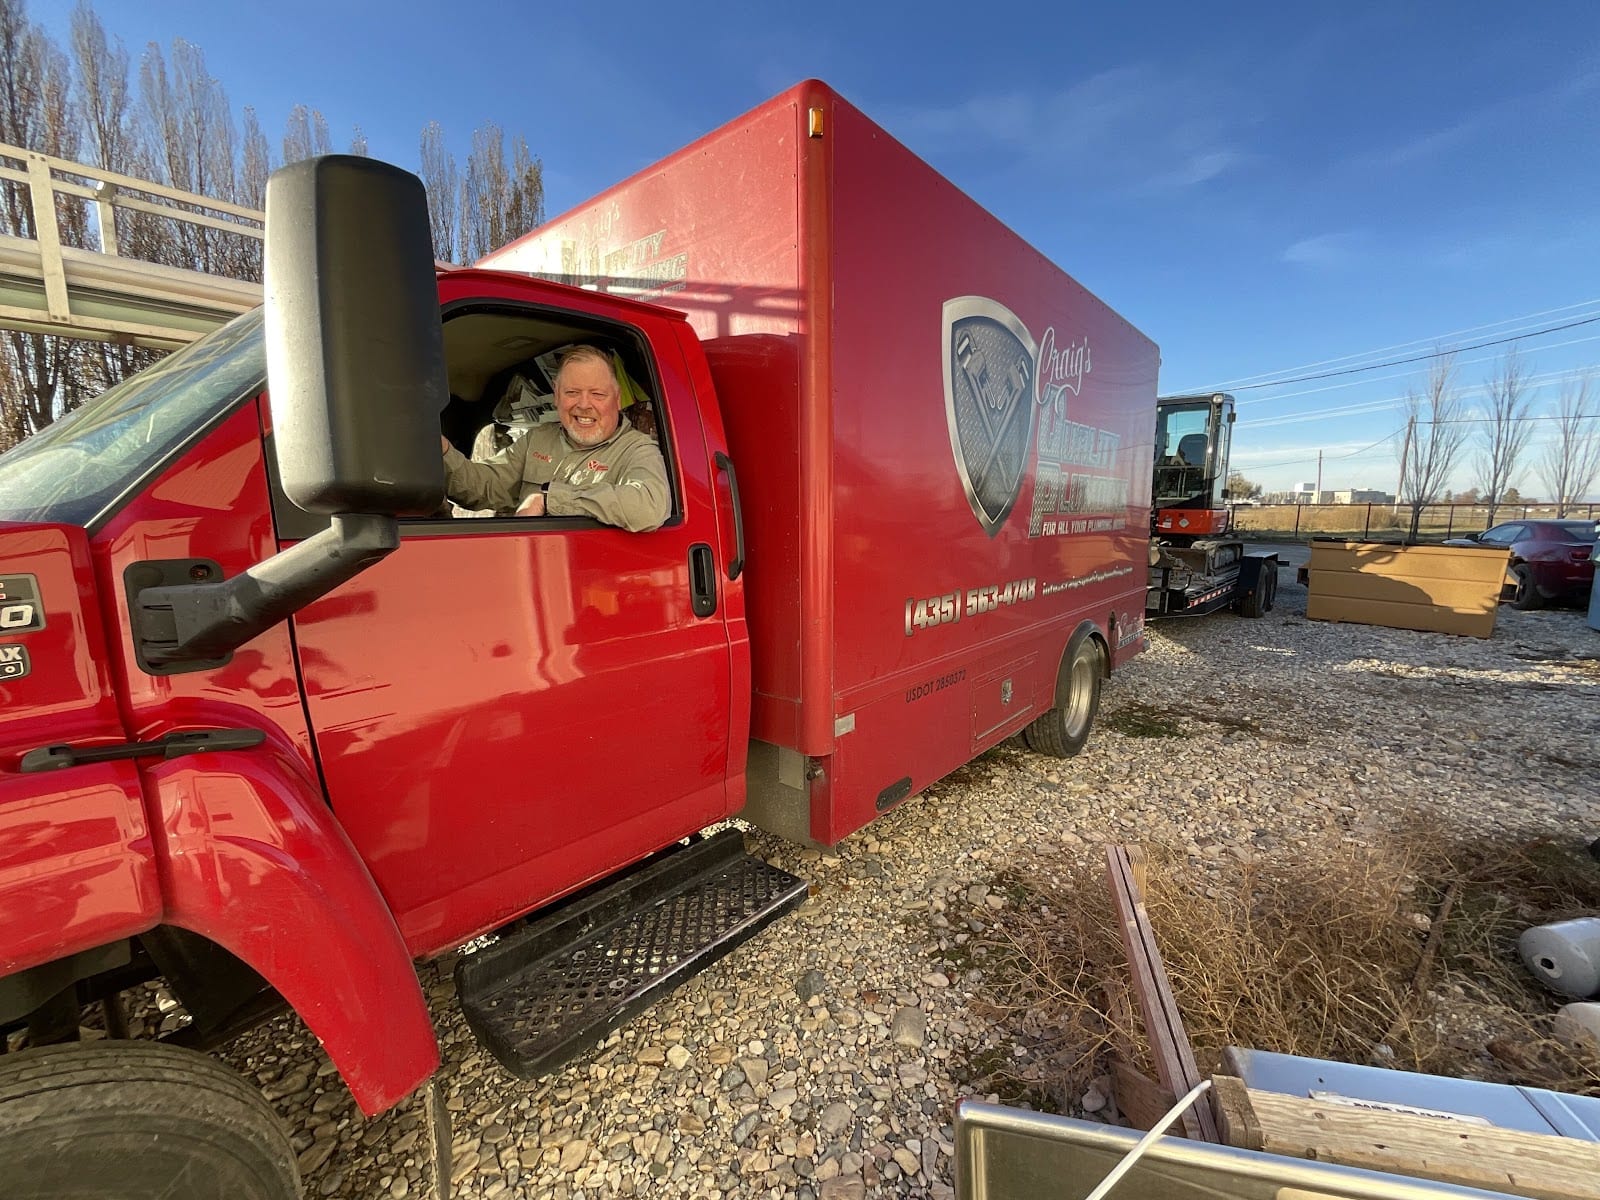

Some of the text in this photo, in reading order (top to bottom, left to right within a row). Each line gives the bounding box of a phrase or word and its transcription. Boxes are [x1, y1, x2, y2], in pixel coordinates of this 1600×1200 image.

[1035, 326, 1093, 415] Craig's
[1037, 383, 1121, 471] QUALITY
[1042, 521, 1056, 537] FOR
[1057, 520, 1069, 534] ALL
[1071, 519, 1087, 534] YOUR
[904, 589, 961, 636] (435)
[905, 681, 934, 703] USDOT
